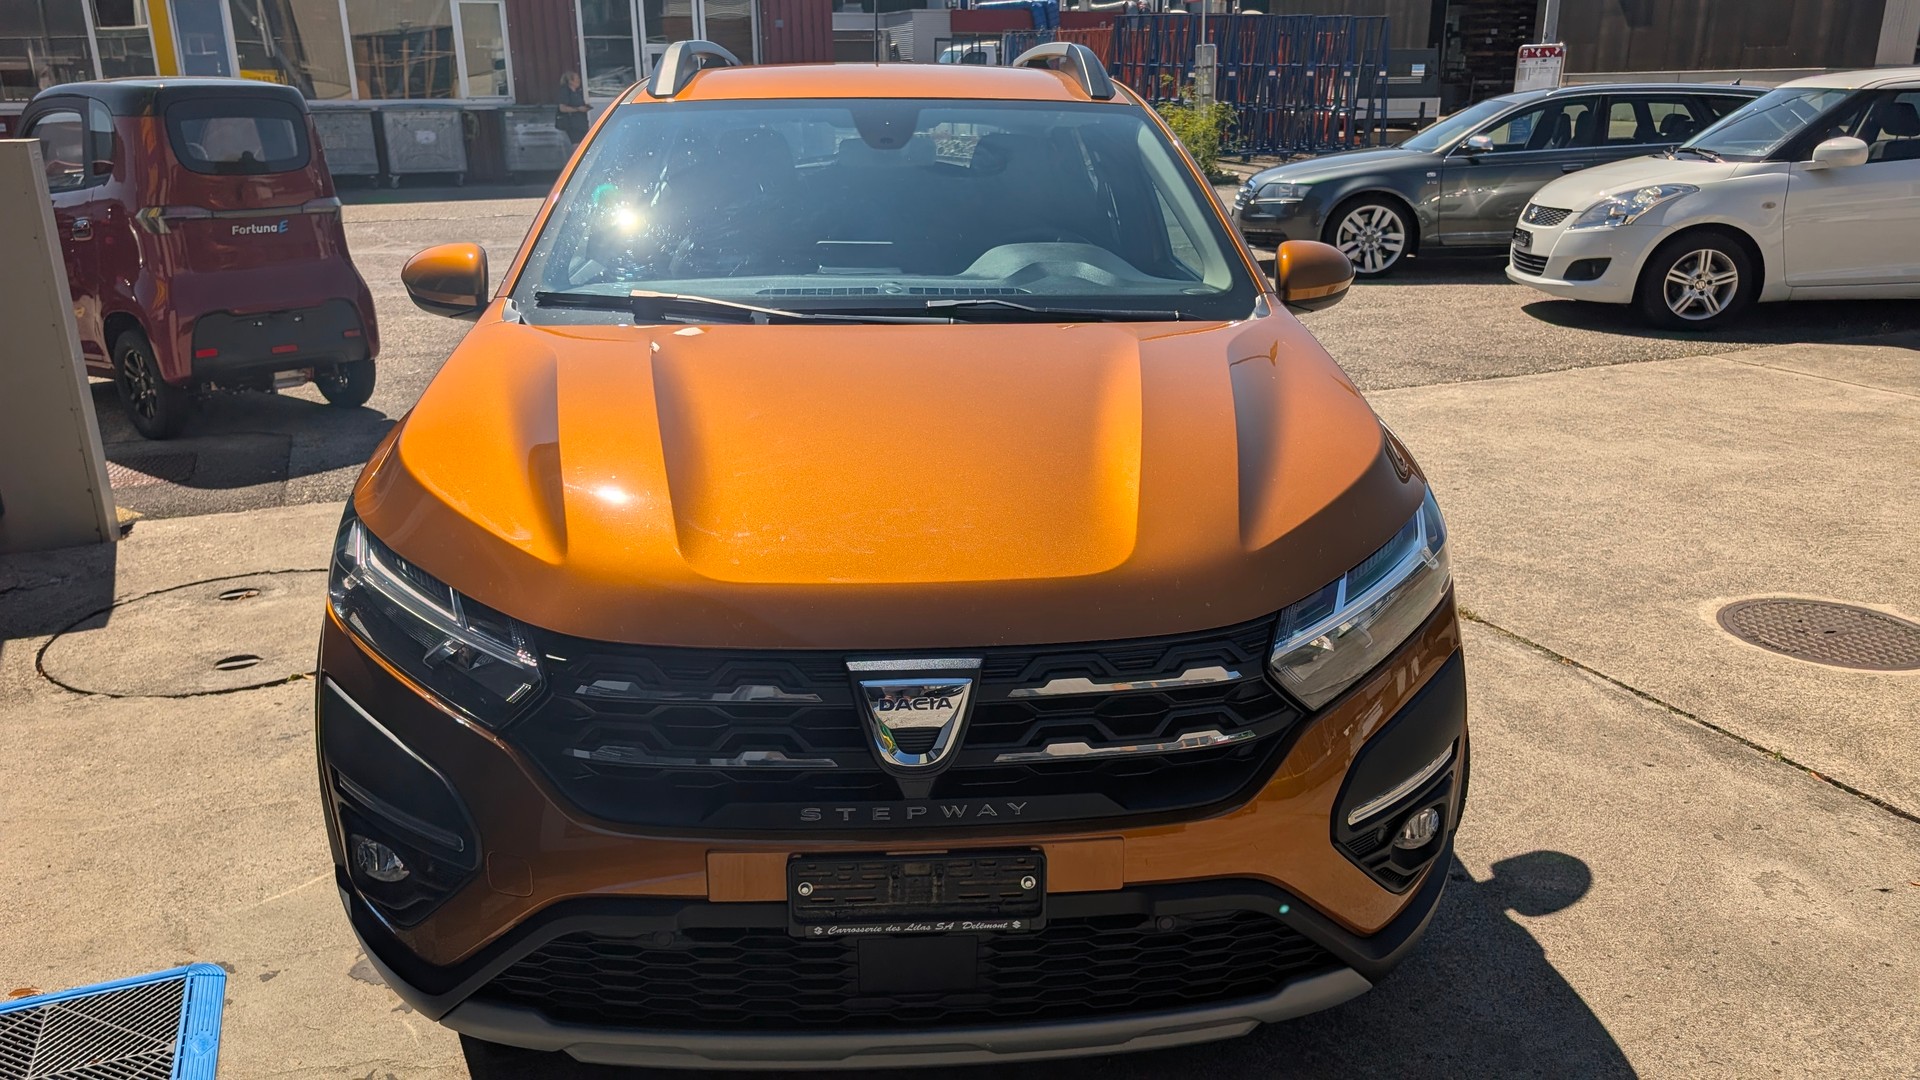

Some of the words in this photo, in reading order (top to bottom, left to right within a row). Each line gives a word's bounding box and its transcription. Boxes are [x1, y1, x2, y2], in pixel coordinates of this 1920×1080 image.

[879, 697, 953, 711] DACIA
[800, 802, 1027, 821] STEPWAY
[827, 925, 882, 935] Carrosserie
[885, 924, 901, 932] des
[904, 923, 931, 931] Lilas
[935, 921, 955, 931] SA
